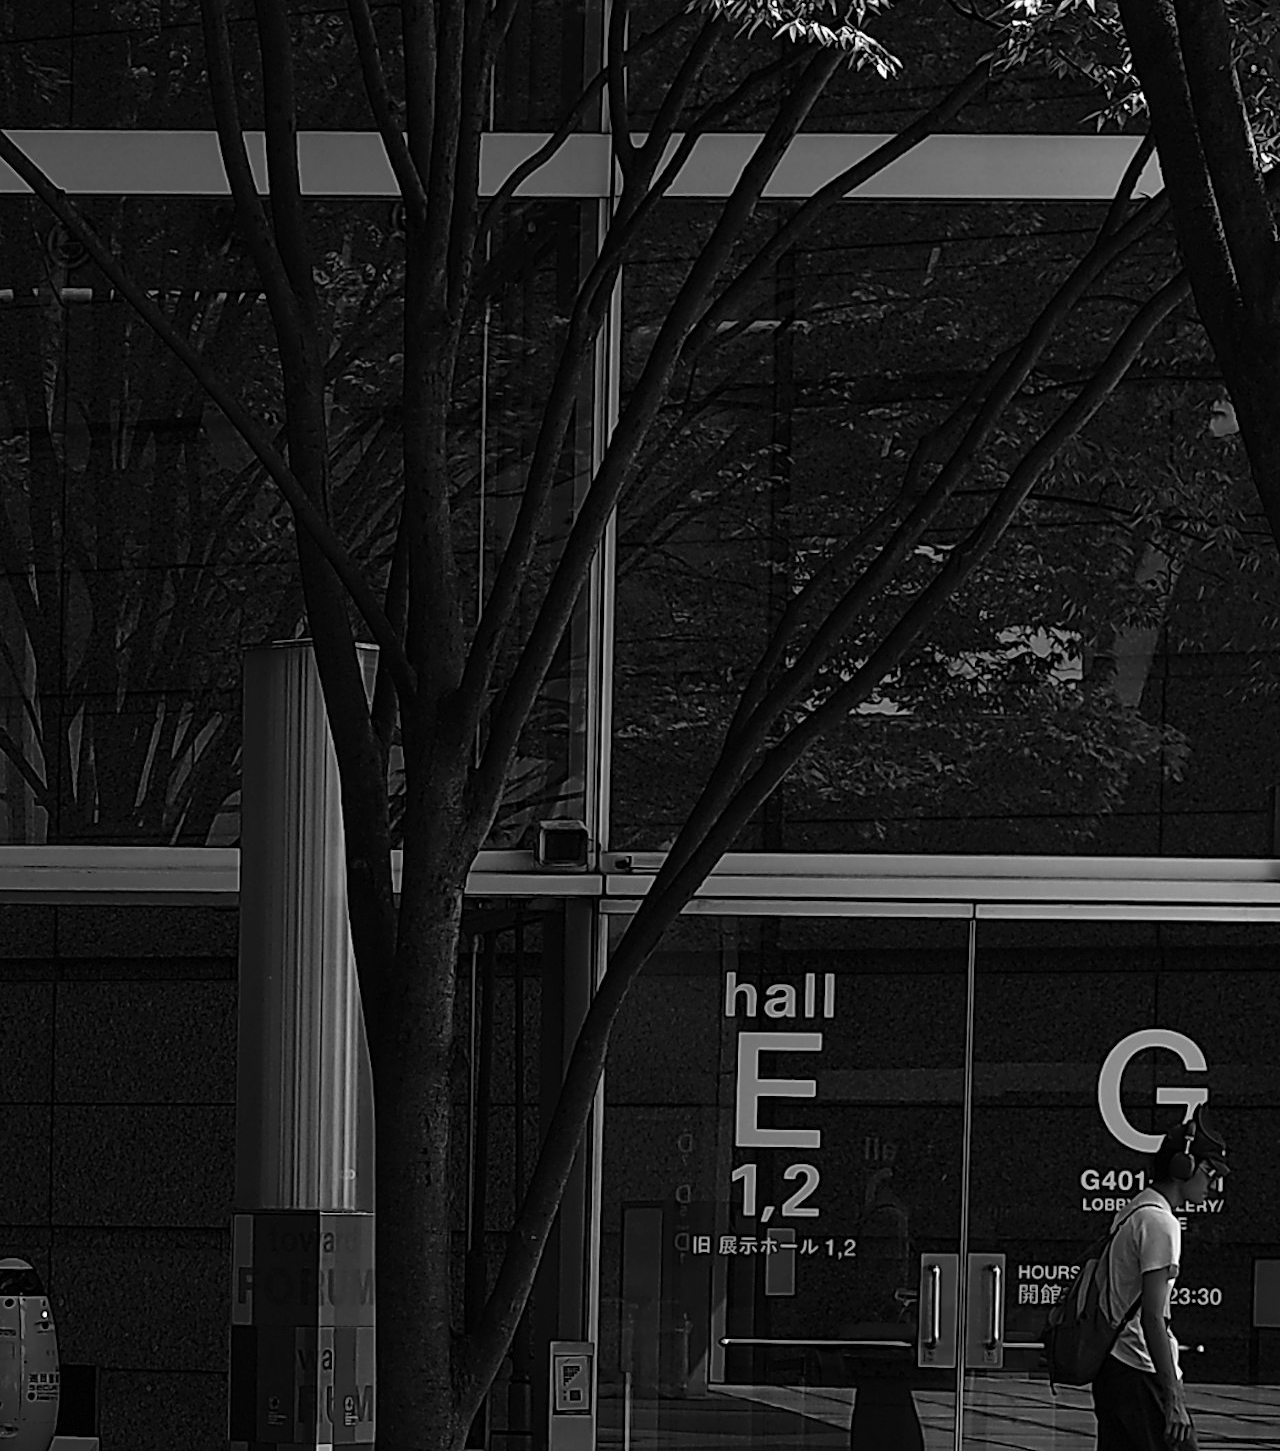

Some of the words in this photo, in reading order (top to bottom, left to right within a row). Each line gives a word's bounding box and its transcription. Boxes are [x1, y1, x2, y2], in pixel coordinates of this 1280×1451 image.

[724, 971, 836, 1018] hall
[735, 1031, 823, 1148] E
[1097, 1028, 1209, 1154] G
[731, 1163, 821, 1223] 1,2
[692, 1235, 711, 1255] 旧
[719, 1235, 820, 1256] 展示ホール
[825, 1239, 858, 1260] 1,2
